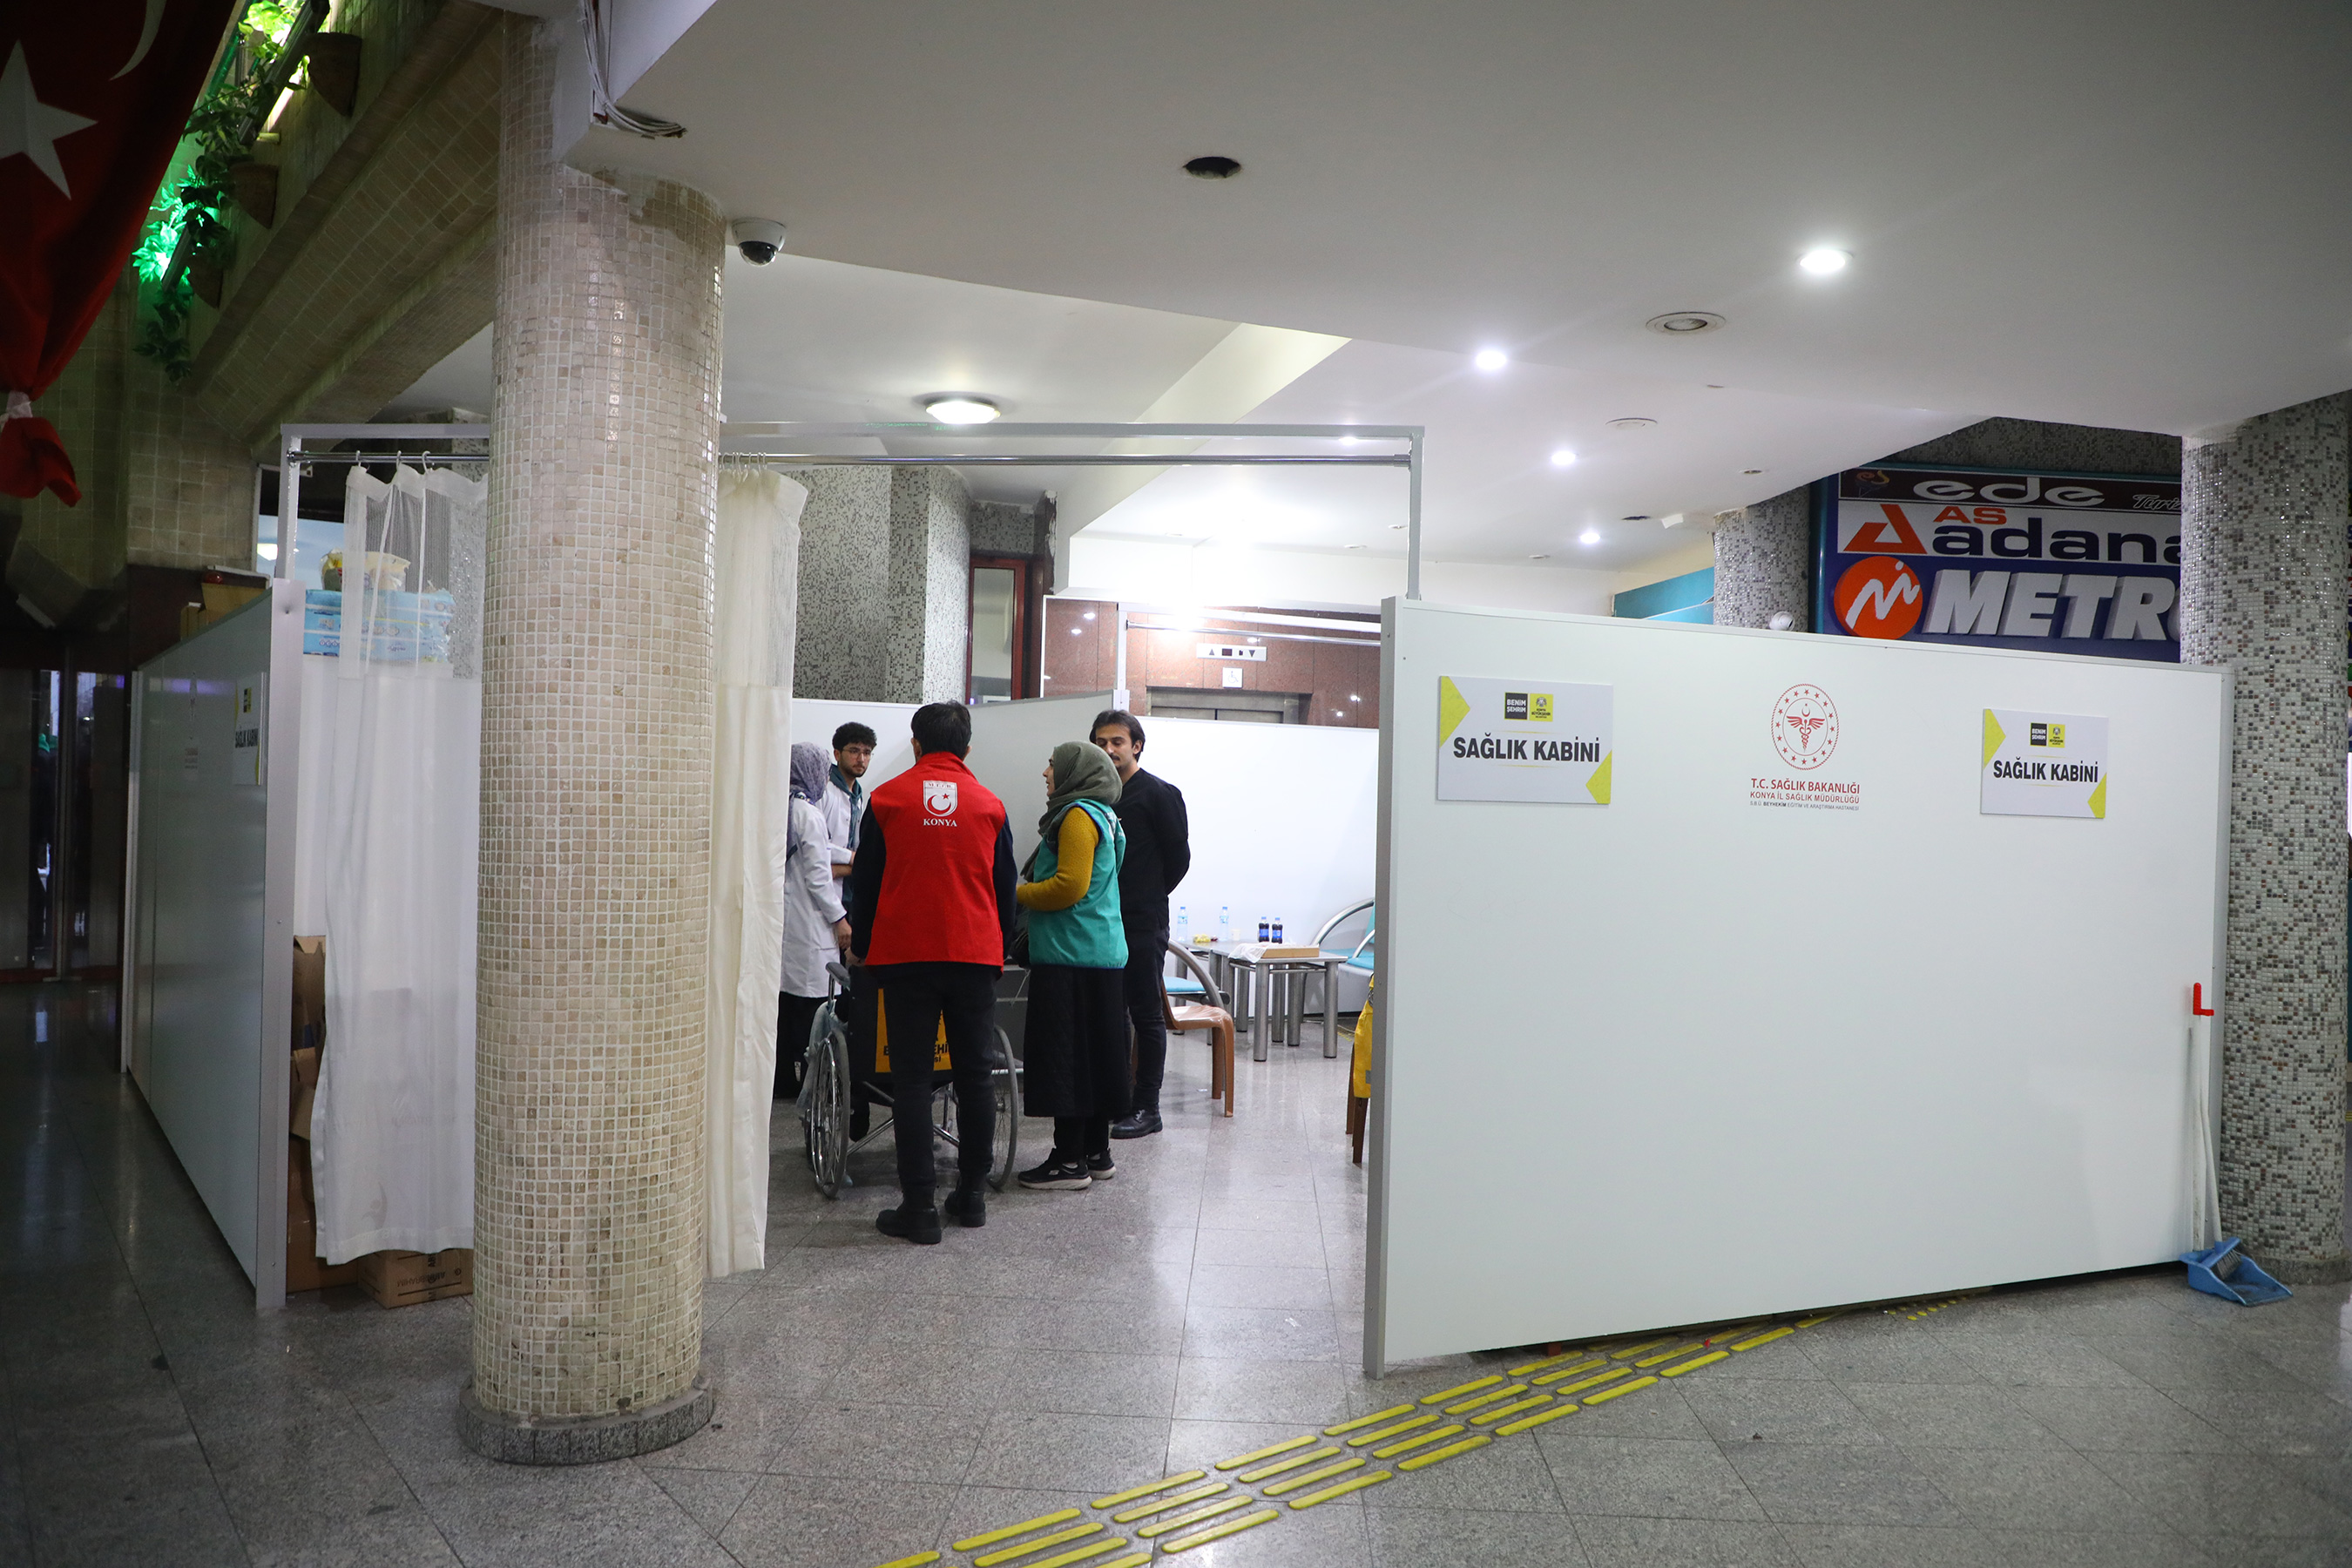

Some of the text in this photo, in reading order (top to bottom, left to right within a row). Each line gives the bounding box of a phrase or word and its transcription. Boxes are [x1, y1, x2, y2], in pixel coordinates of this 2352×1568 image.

[1913, 477, 2105, 506] ede
[1933, 506, 2007, 525] AS
[1922, 569, 2181, 641] METR
[1453, 733, 1599, 762] SAĞLIK KABİNİ
[1993, 756, 2099, 782] SAĞLIK KABİNİ
[1750, 791, 1775, 800] KONYA
[1786, 792, 1813, 801] SAĞLIK
[1815, 794, 1860, 804] MÜDÜRLÜĞÜ
[1751, 778, 1860, 794] T.C. SAĞLIK BAKANLIĞI
